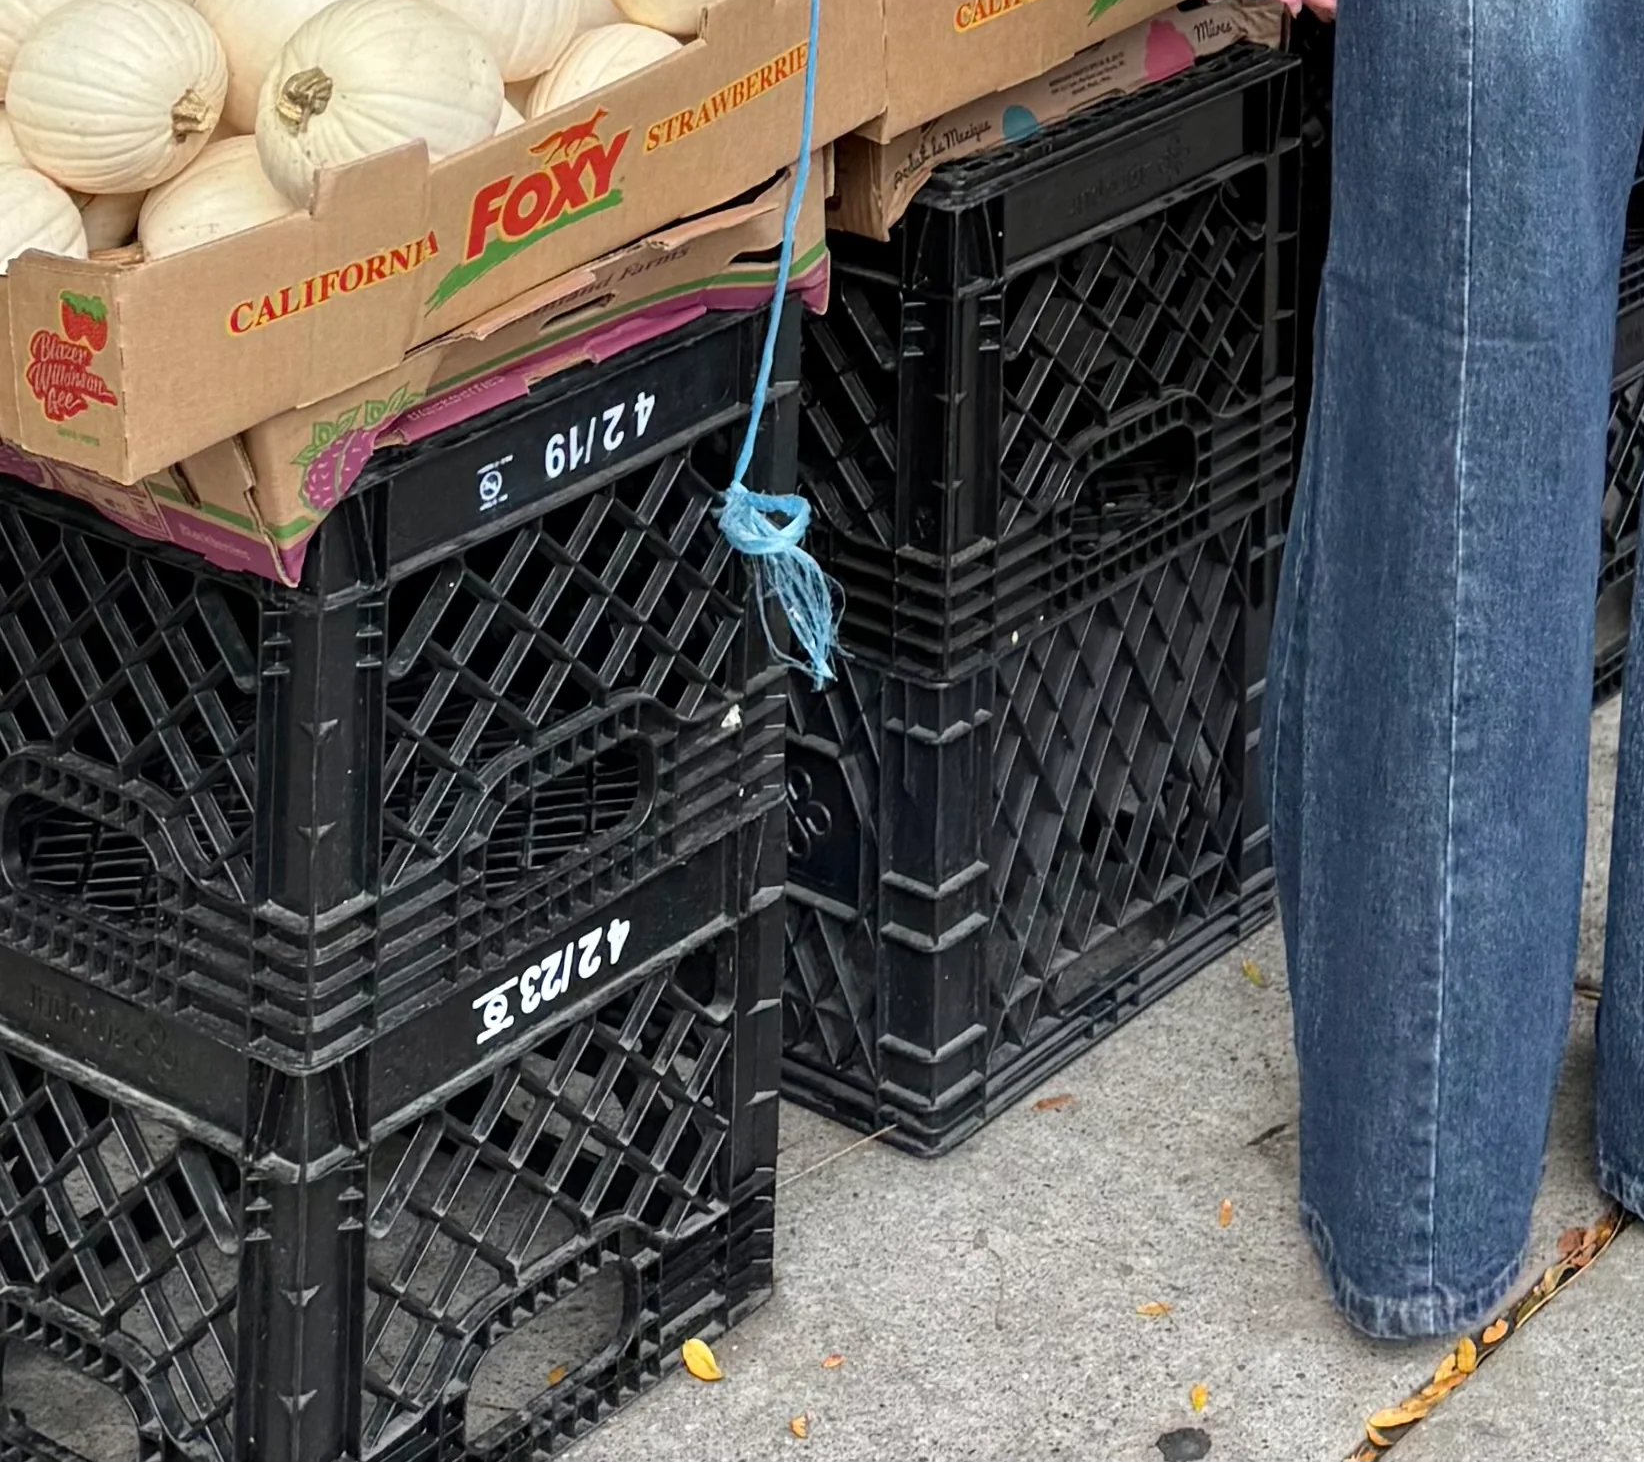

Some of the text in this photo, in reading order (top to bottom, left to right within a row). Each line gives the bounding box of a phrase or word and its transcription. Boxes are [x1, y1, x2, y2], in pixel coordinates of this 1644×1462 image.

[229, 42, 809, 333] CALIFORNIA FOXY STRAWBERRIE
